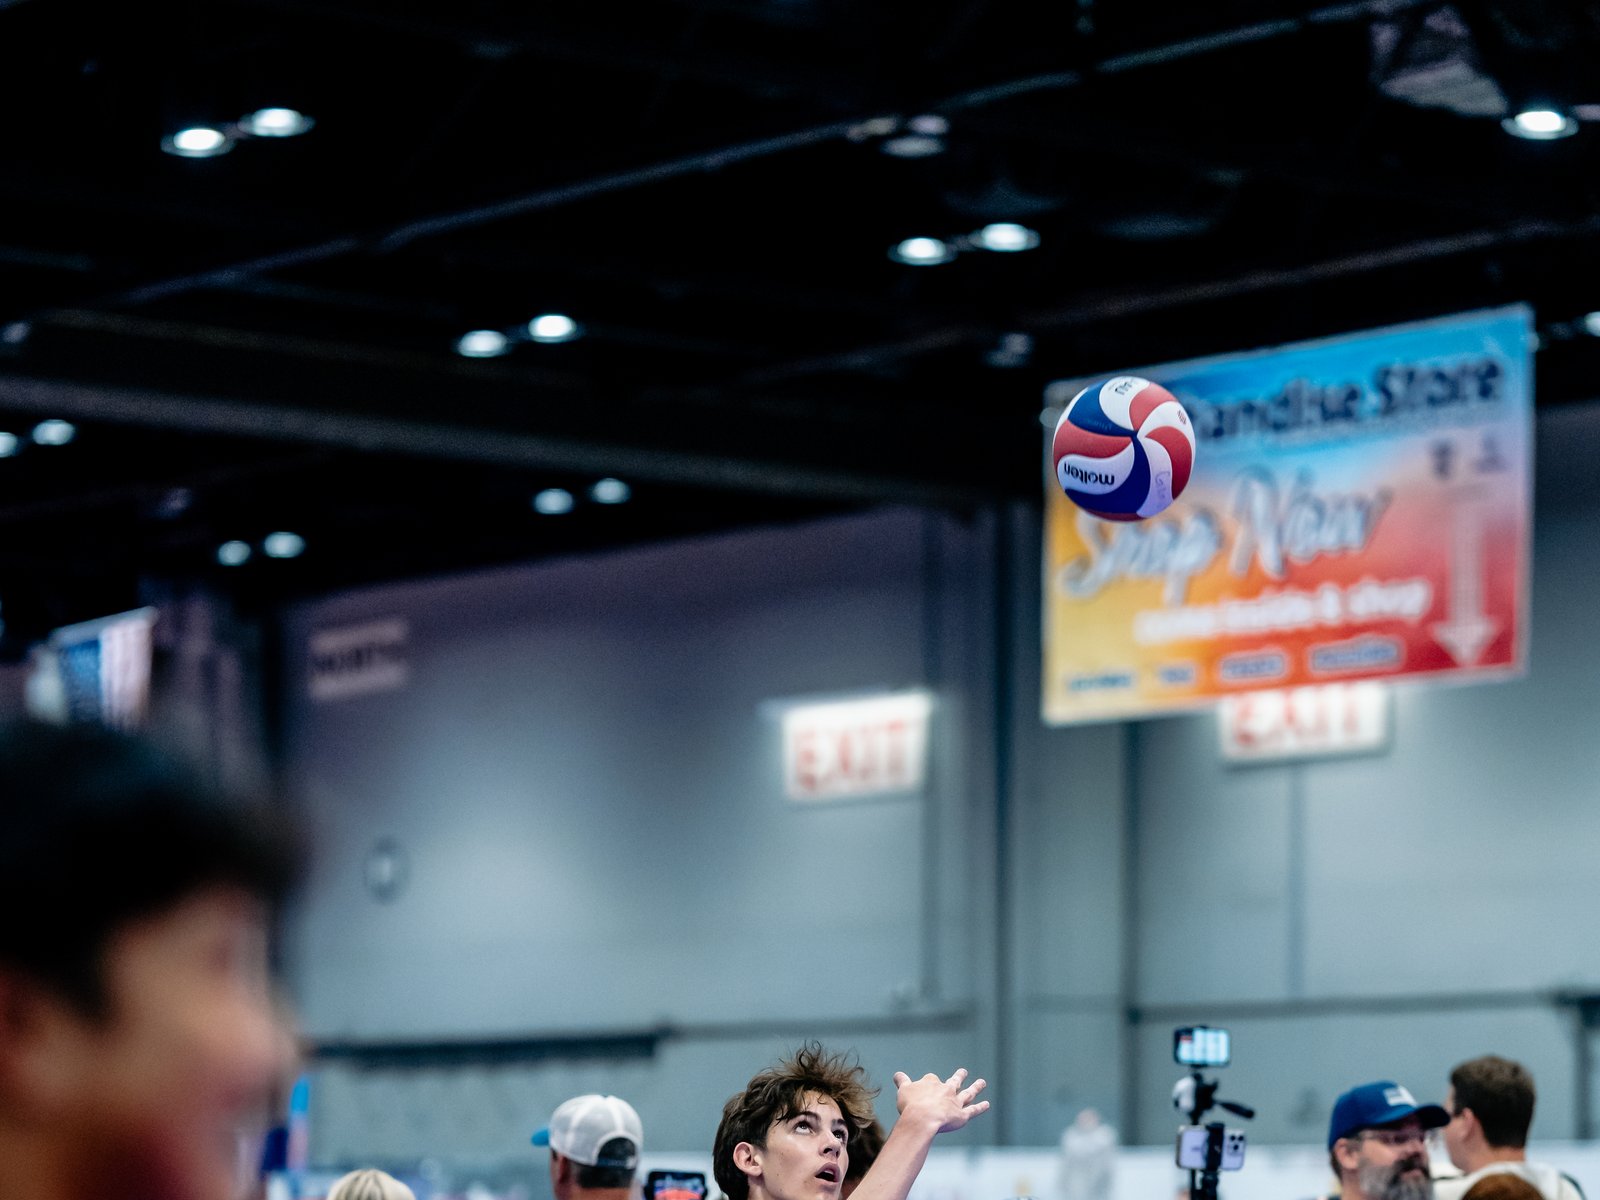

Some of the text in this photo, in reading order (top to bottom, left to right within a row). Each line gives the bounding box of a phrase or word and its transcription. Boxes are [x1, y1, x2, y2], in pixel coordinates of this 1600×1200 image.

[1184, 378, 1362, 441] andise
[1063, 462, 1115, 486] molten
[796, 719, 917, 790] EXIT
